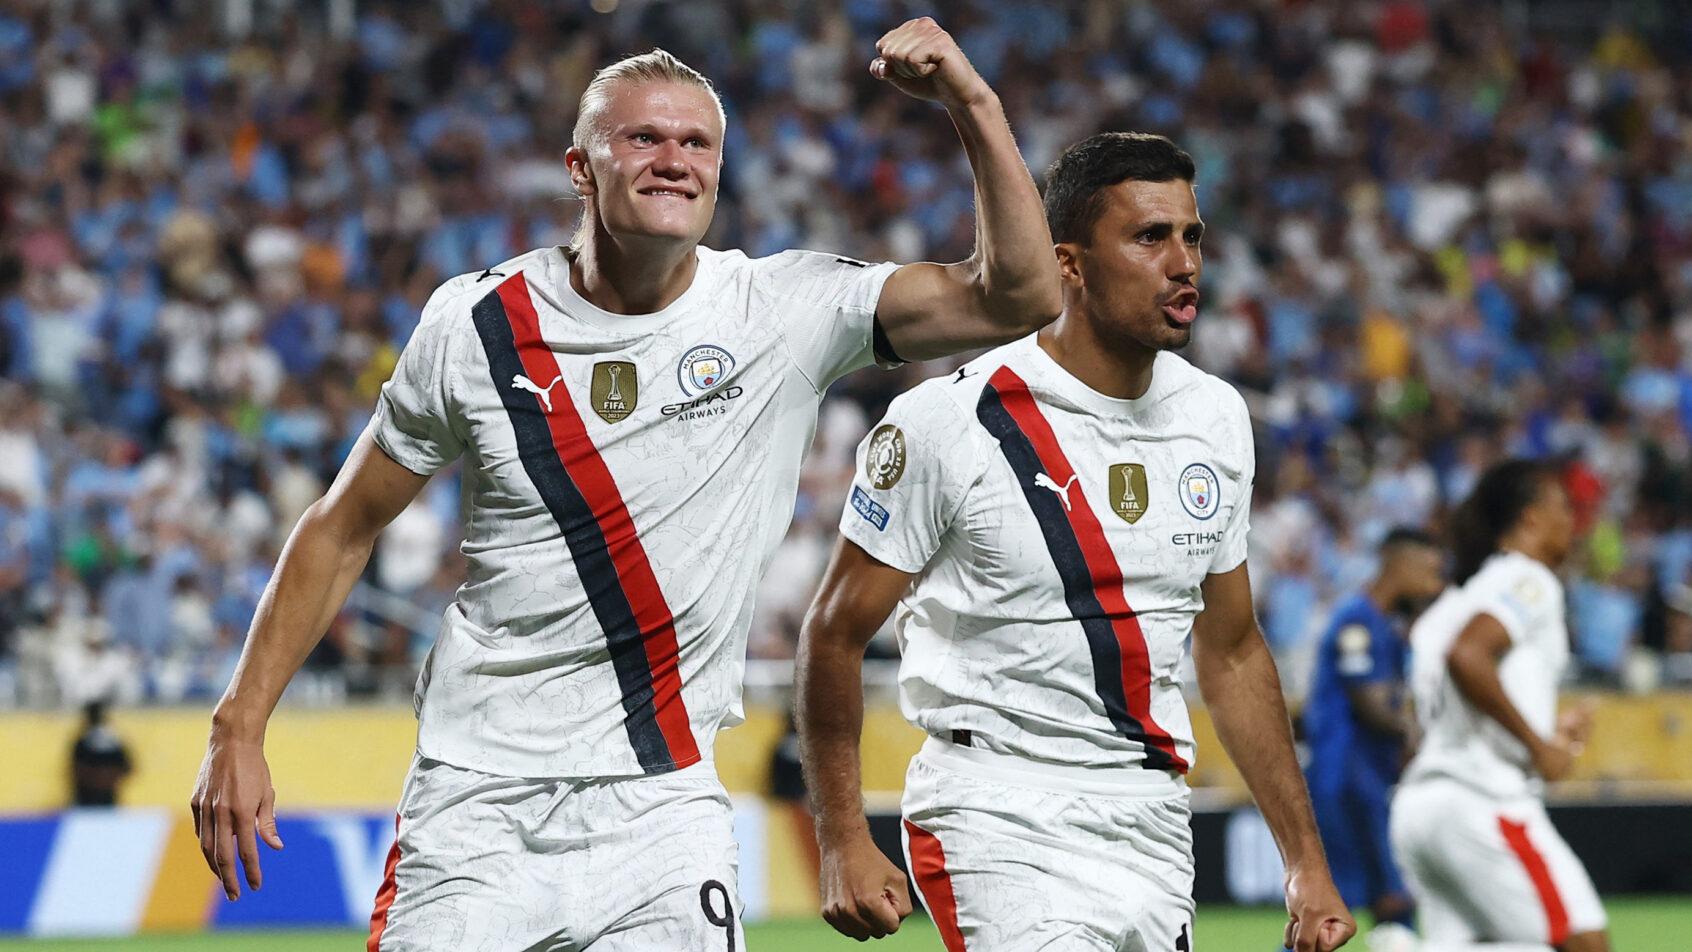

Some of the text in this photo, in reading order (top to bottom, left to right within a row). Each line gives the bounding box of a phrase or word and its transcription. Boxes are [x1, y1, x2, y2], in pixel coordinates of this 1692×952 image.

[683, 349, 729, 370] MANCHESTER
[603, 401, 625, 410] FIFA
[661, 386, 743, 416] ETIHAD
[677, 405, 726, 423] AIRWAYS
[894, 438, 902, 454] CUP
[1172, 531, 1224, 545] ETIHAD
[699, 880, 736, 952] 9
